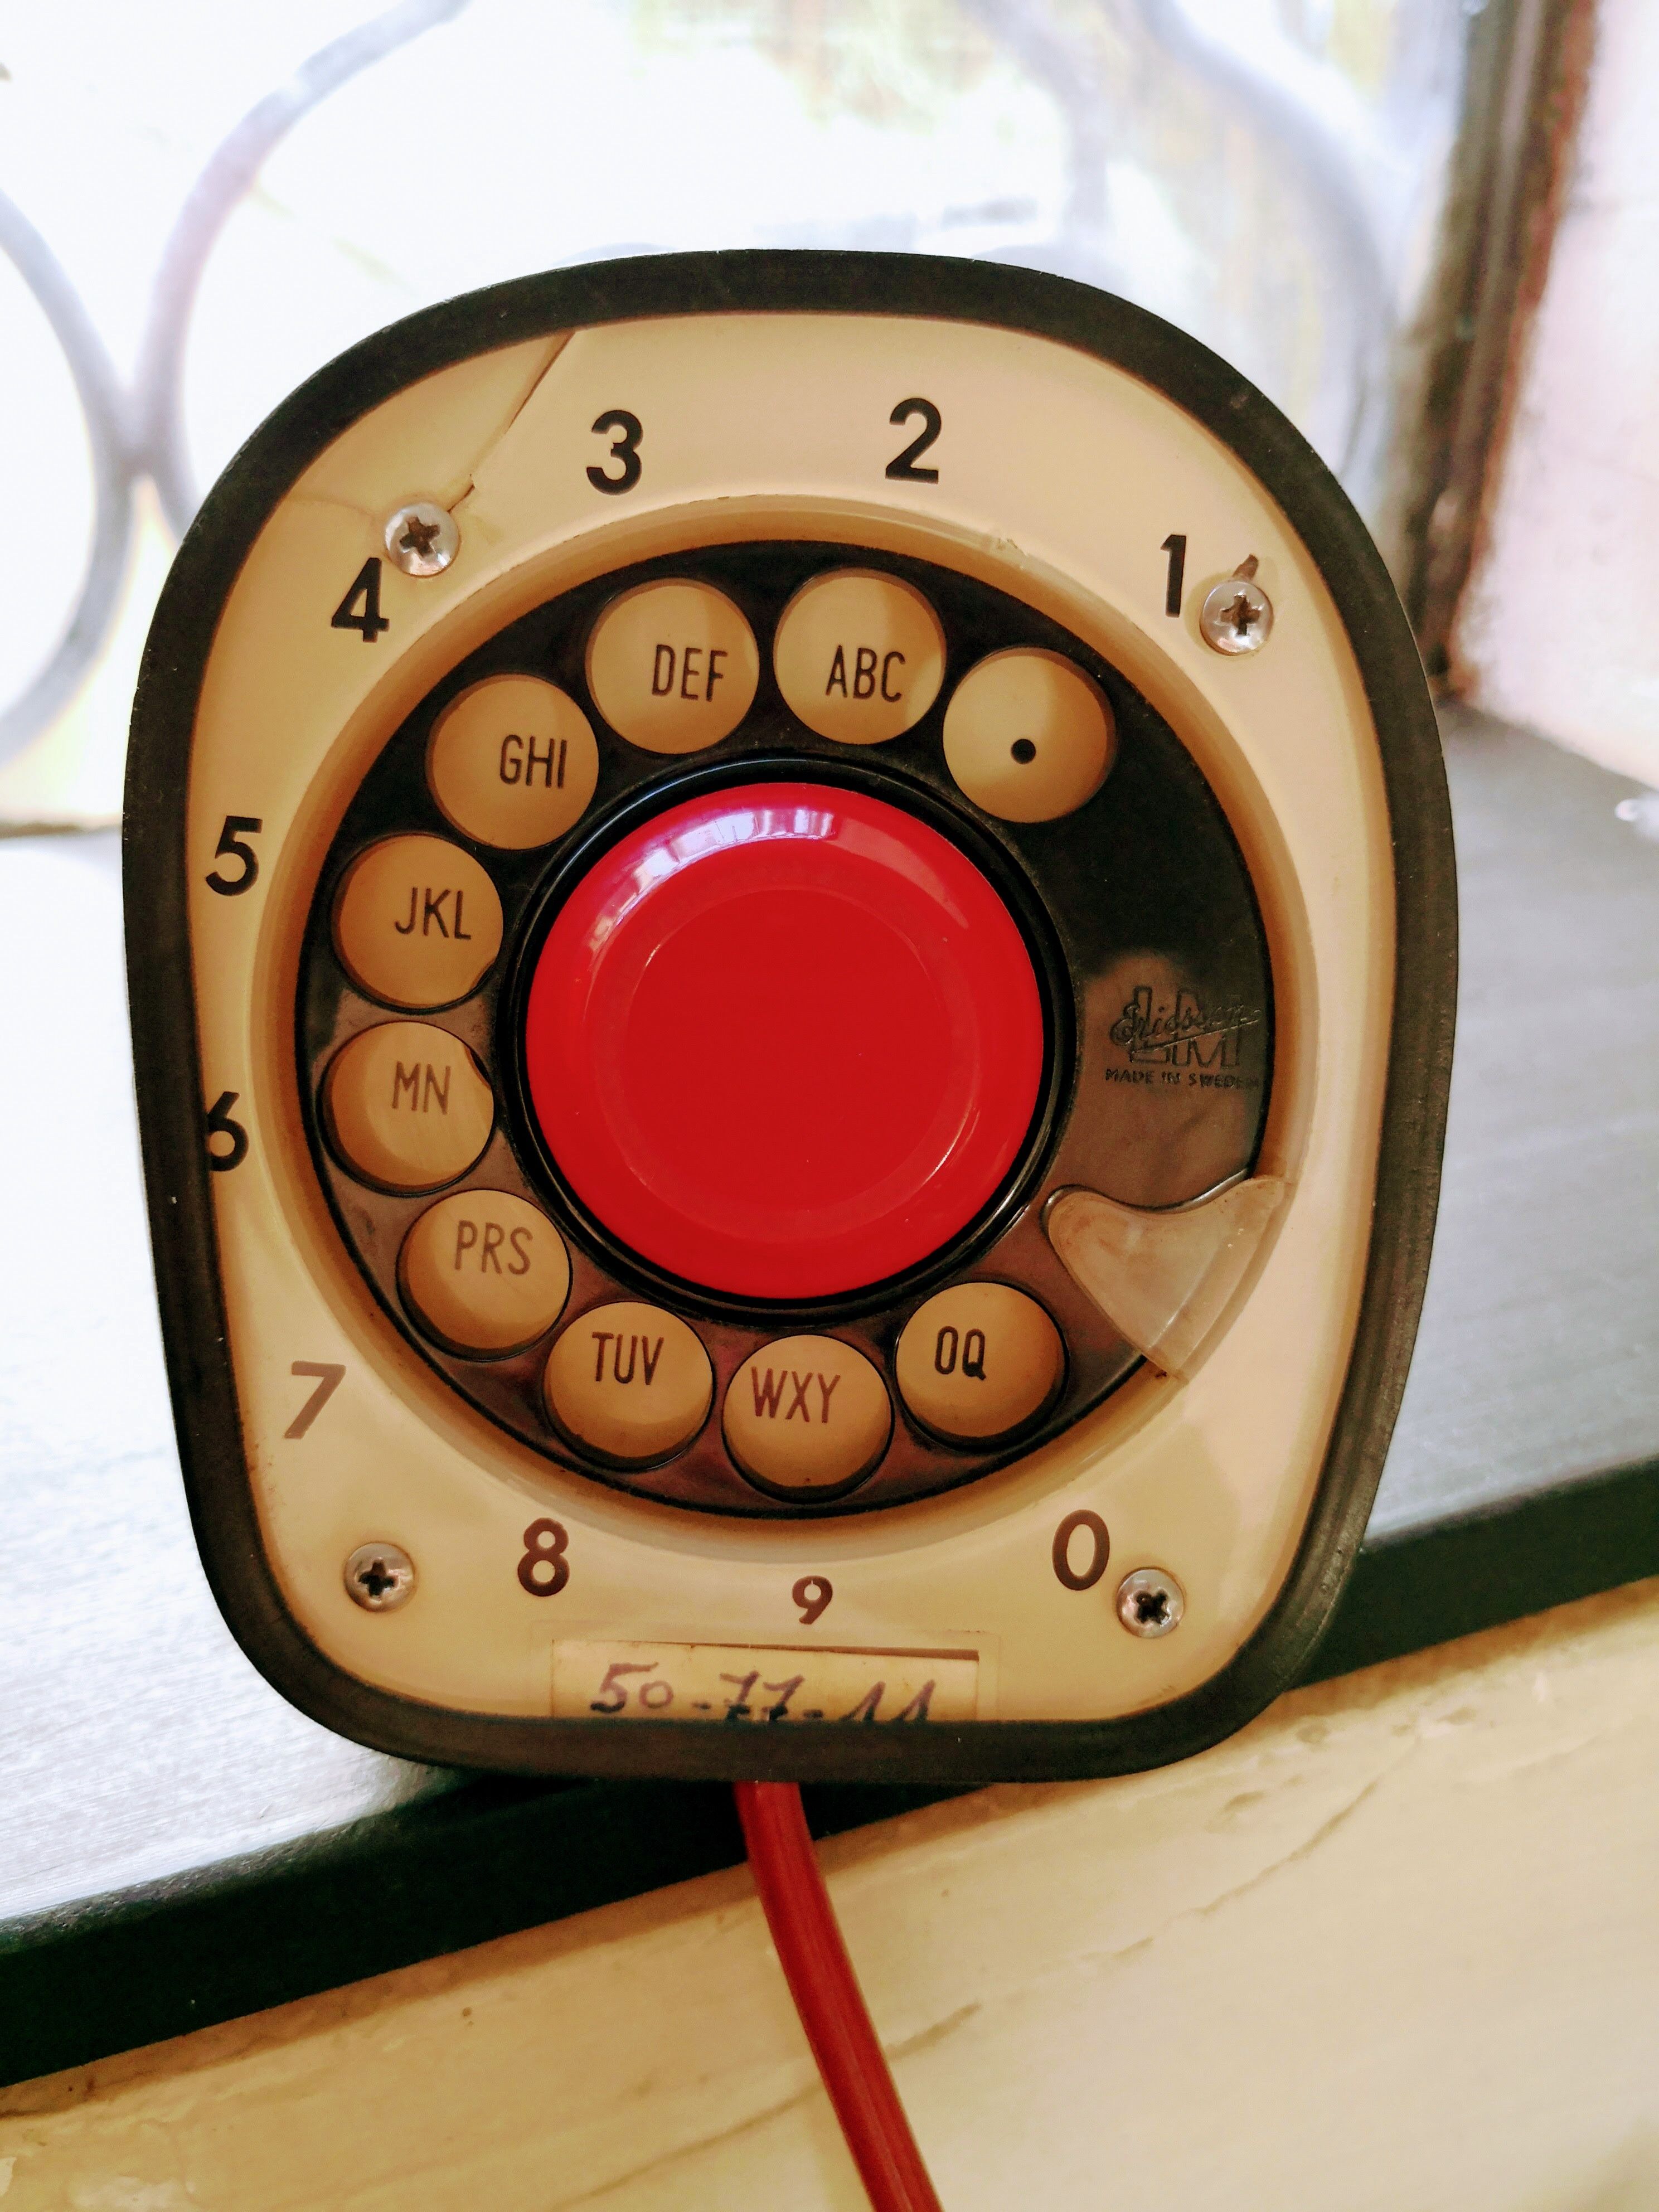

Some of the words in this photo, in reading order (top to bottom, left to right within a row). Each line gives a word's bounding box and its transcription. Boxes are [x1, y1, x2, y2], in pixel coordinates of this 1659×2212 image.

[586, 410, 643, 496] 3
[885, 398, 942, 484] 2
[331, 557, 389, 642] 4
[1160, 534, 1187, 618] 1
[652, 644, 728, 702] DEF
[825, 644, 905, 703] ABC
[500, 734, 567, 788] GHI
[206, 816, 263, 896] 5
[395, 887, 472, 940] JKL
[391, 1061, 451, 1114] MN
[1105, 1068, 1154, 1084] MADE
[1161, 1071, 1180, 1085] IN
[205, 1091, 249, 1171] 6
[454, 1220, 533, 1275] PRS
[591, 1332, 664, 1385] TUV
[283, 1361, 346, 1439] 7
[751, 1366, 841, 1423] WXY
[518, 1517, 570, 1597] 8
[1052, 1510, 1110, 1591] 0
[792, 1575, 833, 1624] 9
